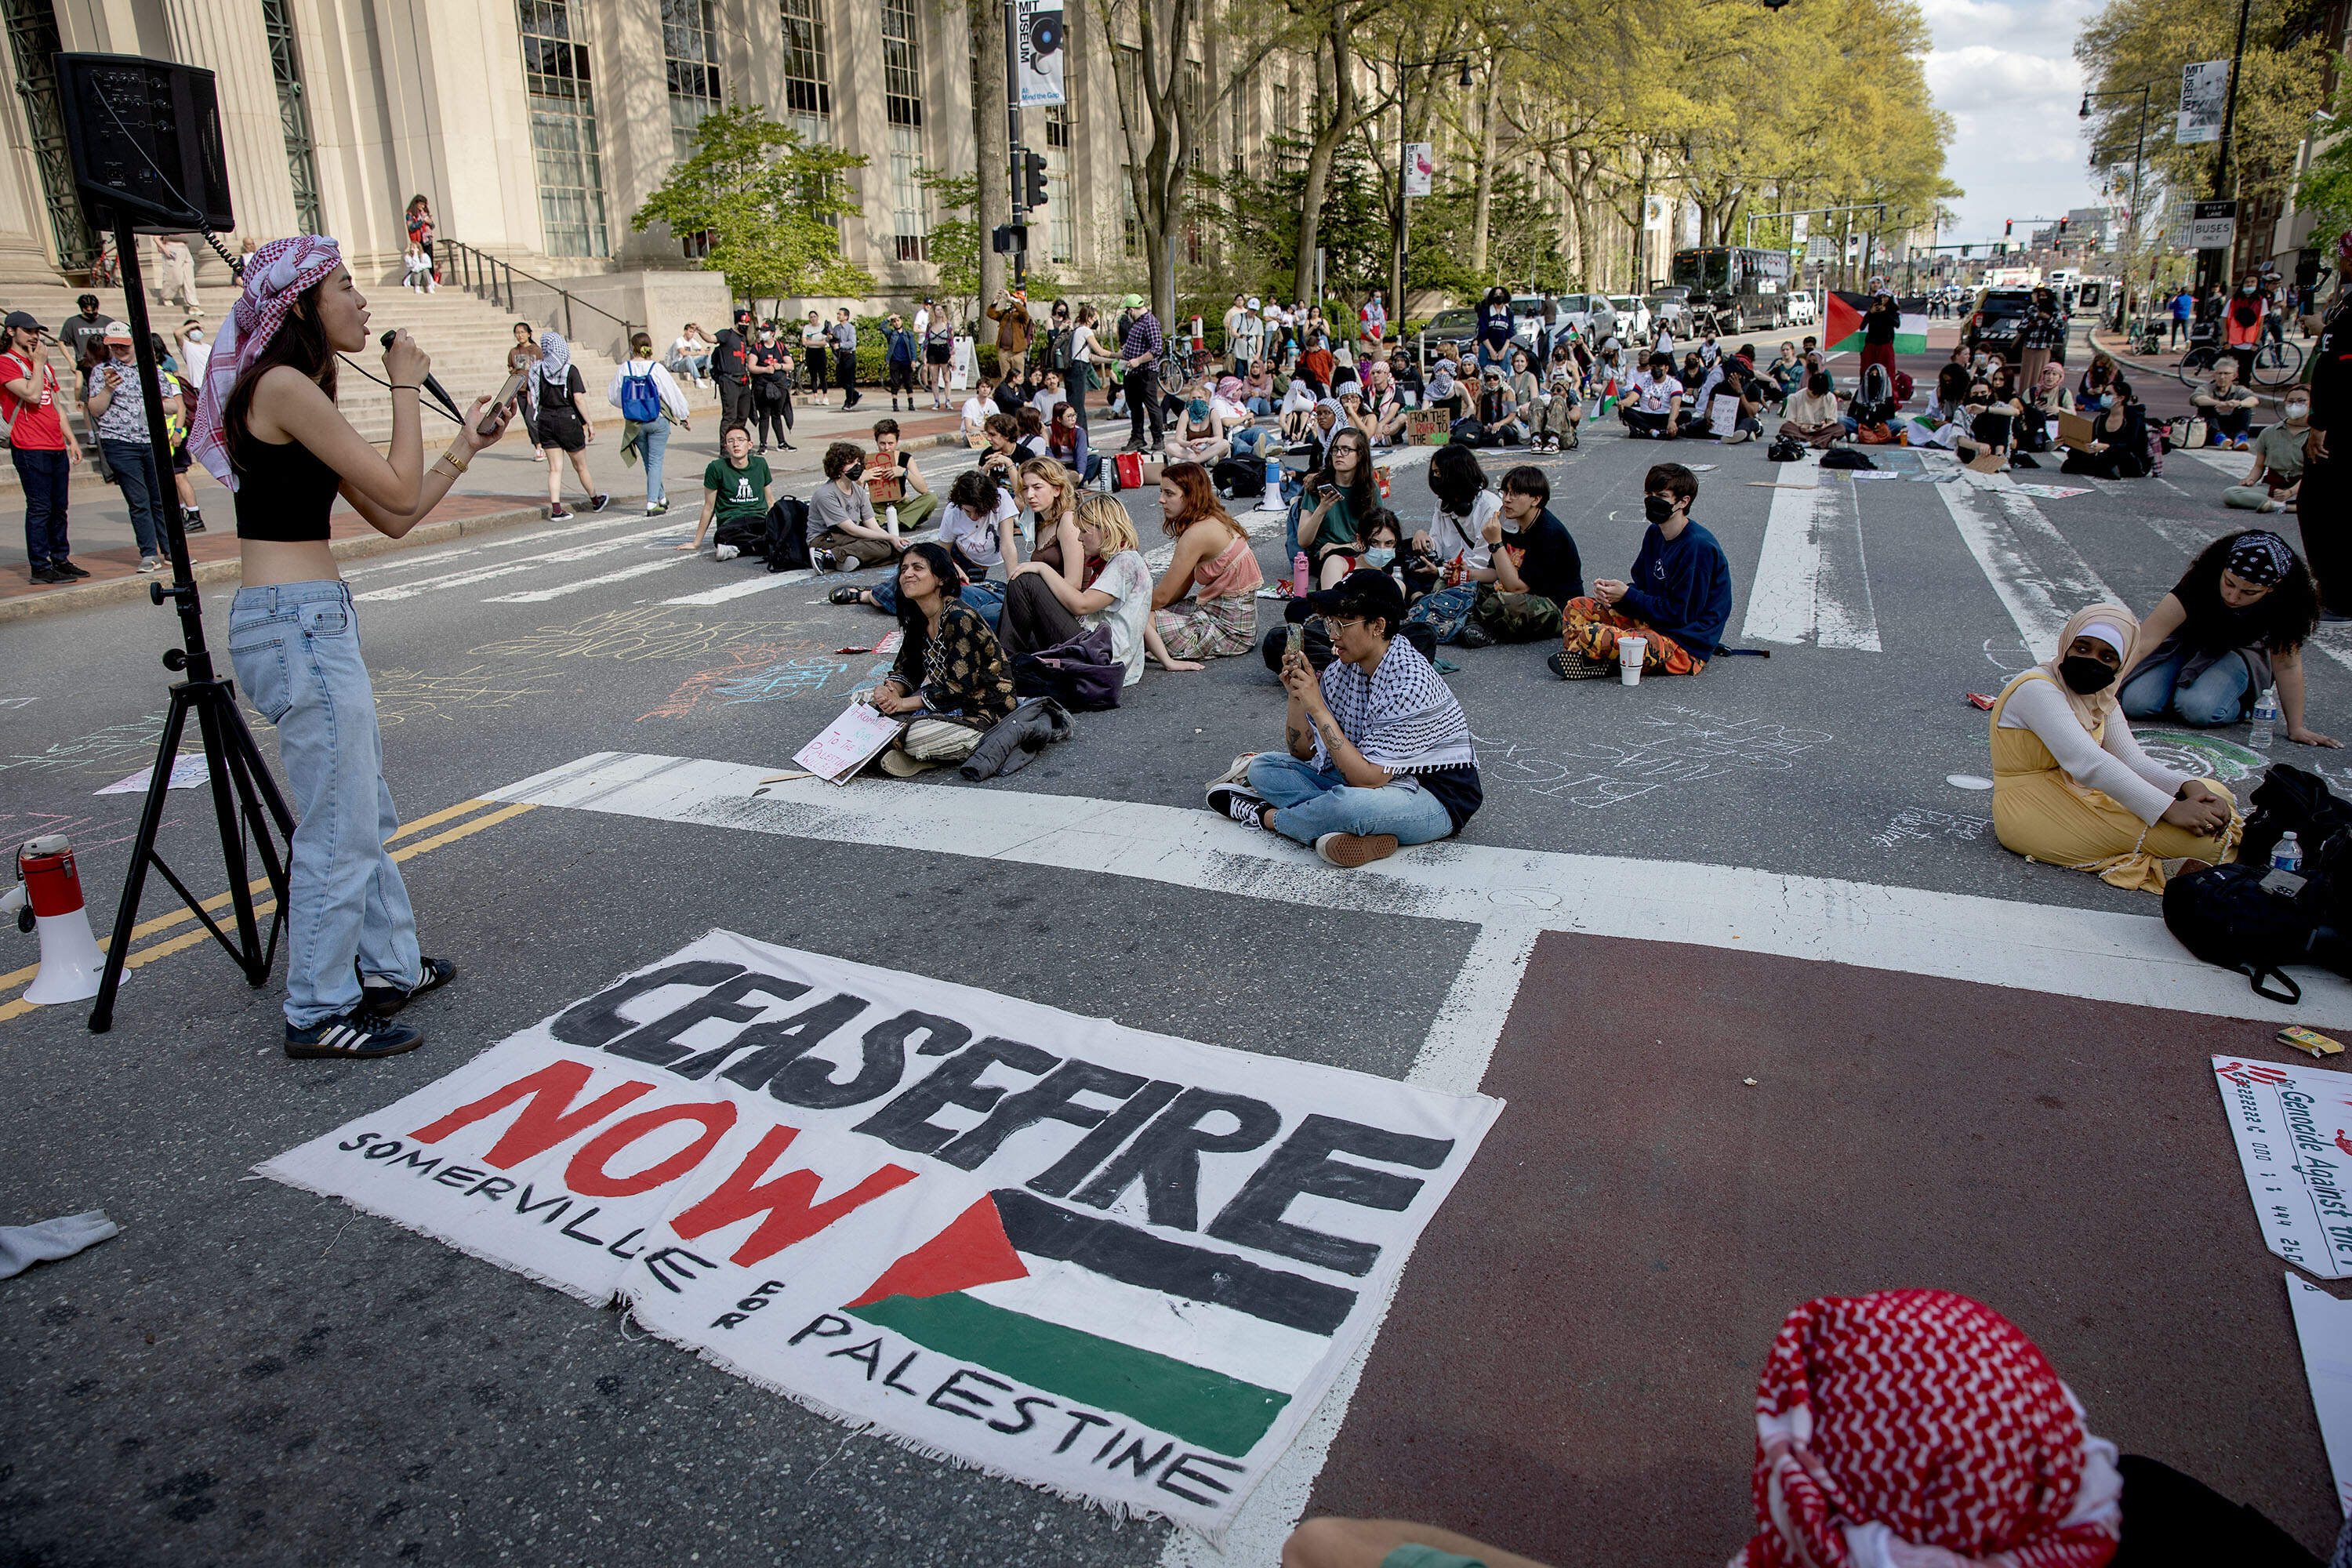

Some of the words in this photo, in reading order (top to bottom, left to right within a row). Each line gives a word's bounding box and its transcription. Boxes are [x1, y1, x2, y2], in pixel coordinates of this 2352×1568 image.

[1019, 1, 1040, 13] MIT
[2186, 64, 2206, 74] MIT
[1047, 91, 1060, 100] Gap
[2195, 223, 2230, 234] BUSES
[1410, 411, 1428, 424] FROM
[1429, 409, 1446, 423] THE
[1416, 422, 1436, 434] RIVER
[1436, 422, 1448, 434] TO
[1410, 433, 1426, 445] THE
[1430, 432, 1450, 445] SEA
[851, 704, 877, 727] FROM
[876, 717, 891, 731] THE
[827, 731, 841, 746] TO
[840, 739, 856, 753] THE
[801, 754, 818, 772] WILL
[804, 742, 854, 769] PALESTINE
[550, 960, 1455, 1278] CEASEFIRE
[2281, 1091, 2336, 1152] Genocide
[407, 1058, 920, 1269] NOW
[2291, 1155, 2352, 1217] Against
[339, 1131, 719, 1294] SOMERVILLE
[710, 1280, 786, 1330] FOR
[788, 1313, 1248, 1508] PALESTINE
